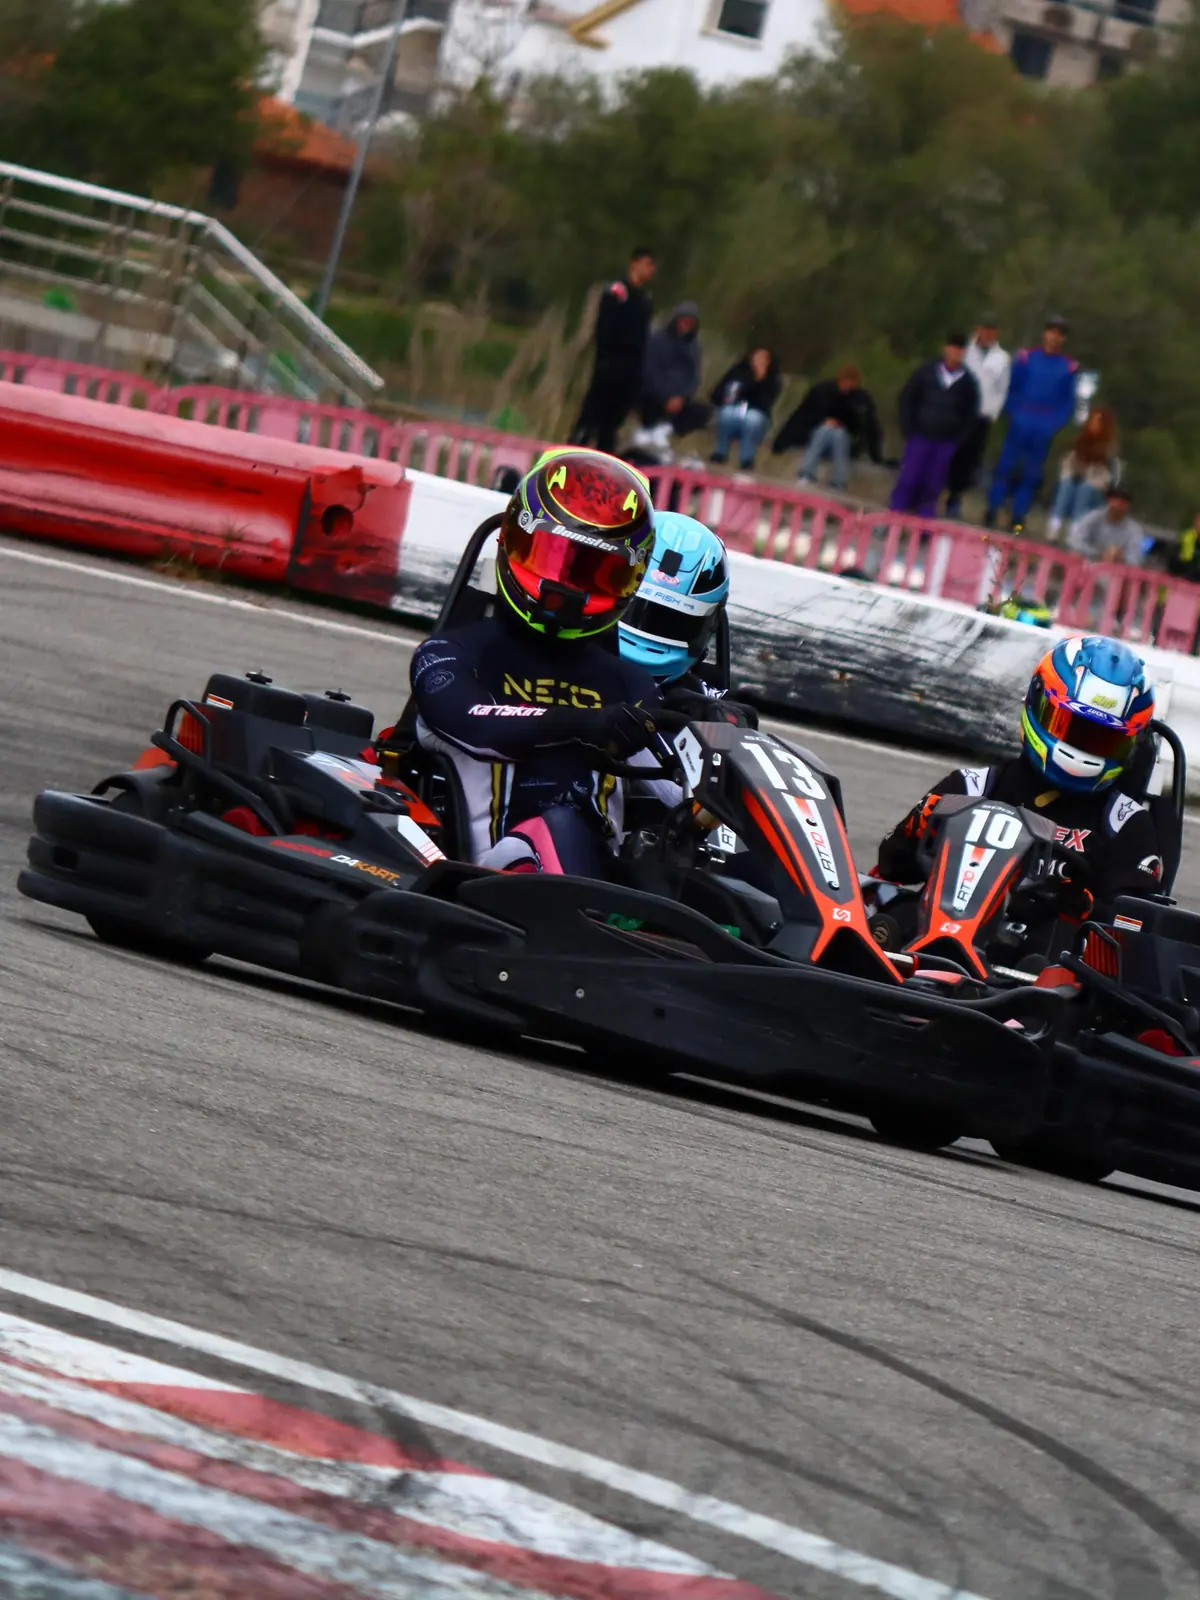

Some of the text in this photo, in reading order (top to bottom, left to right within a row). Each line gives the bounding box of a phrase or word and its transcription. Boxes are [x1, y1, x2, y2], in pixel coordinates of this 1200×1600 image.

[741, 741, 827, 801] 13
[965, 808, 1023, 850] 10
[330, 854, 401, 882] DAKART
